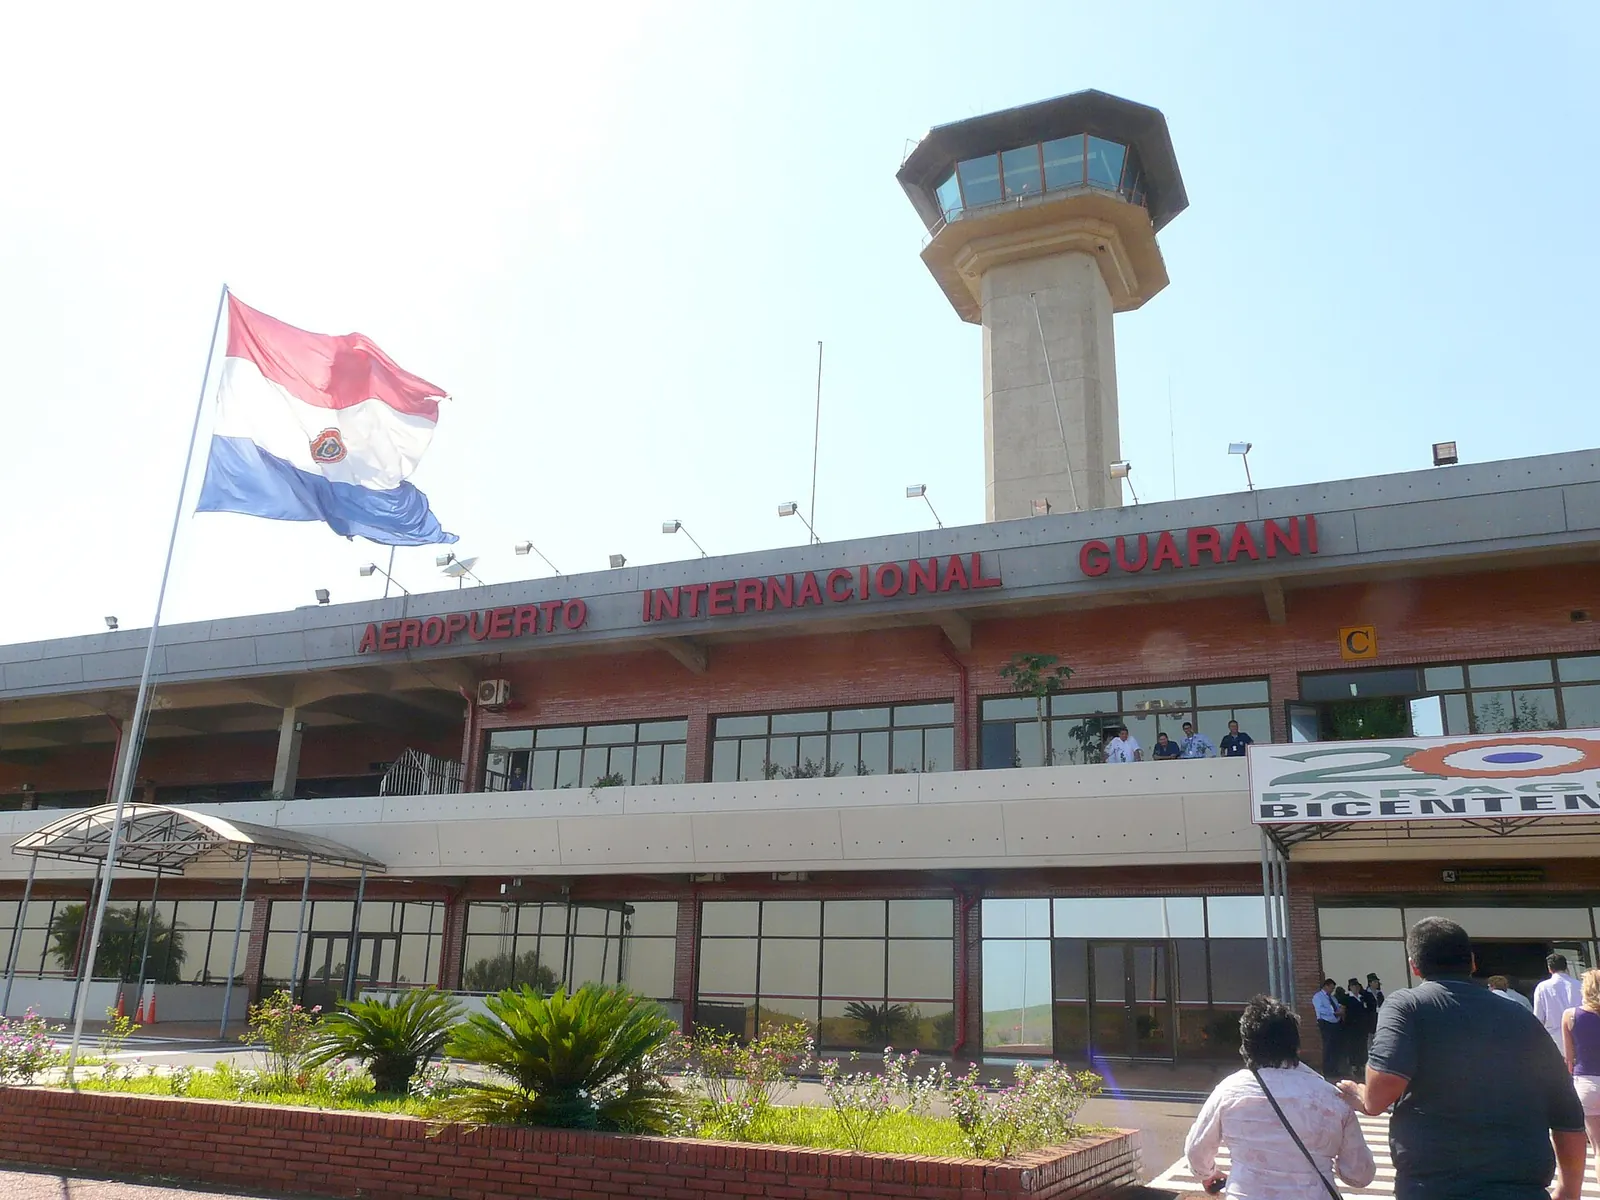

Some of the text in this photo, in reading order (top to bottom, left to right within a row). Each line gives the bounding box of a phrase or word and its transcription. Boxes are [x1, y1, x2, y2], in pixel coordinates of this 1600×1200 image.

[358, 513, 1318, 654] AEROPUERTO INTERNACIONAL GUARANI
[1346, 630, 1369, 654] C
[1262, 781, 1600, 802] PARAG
